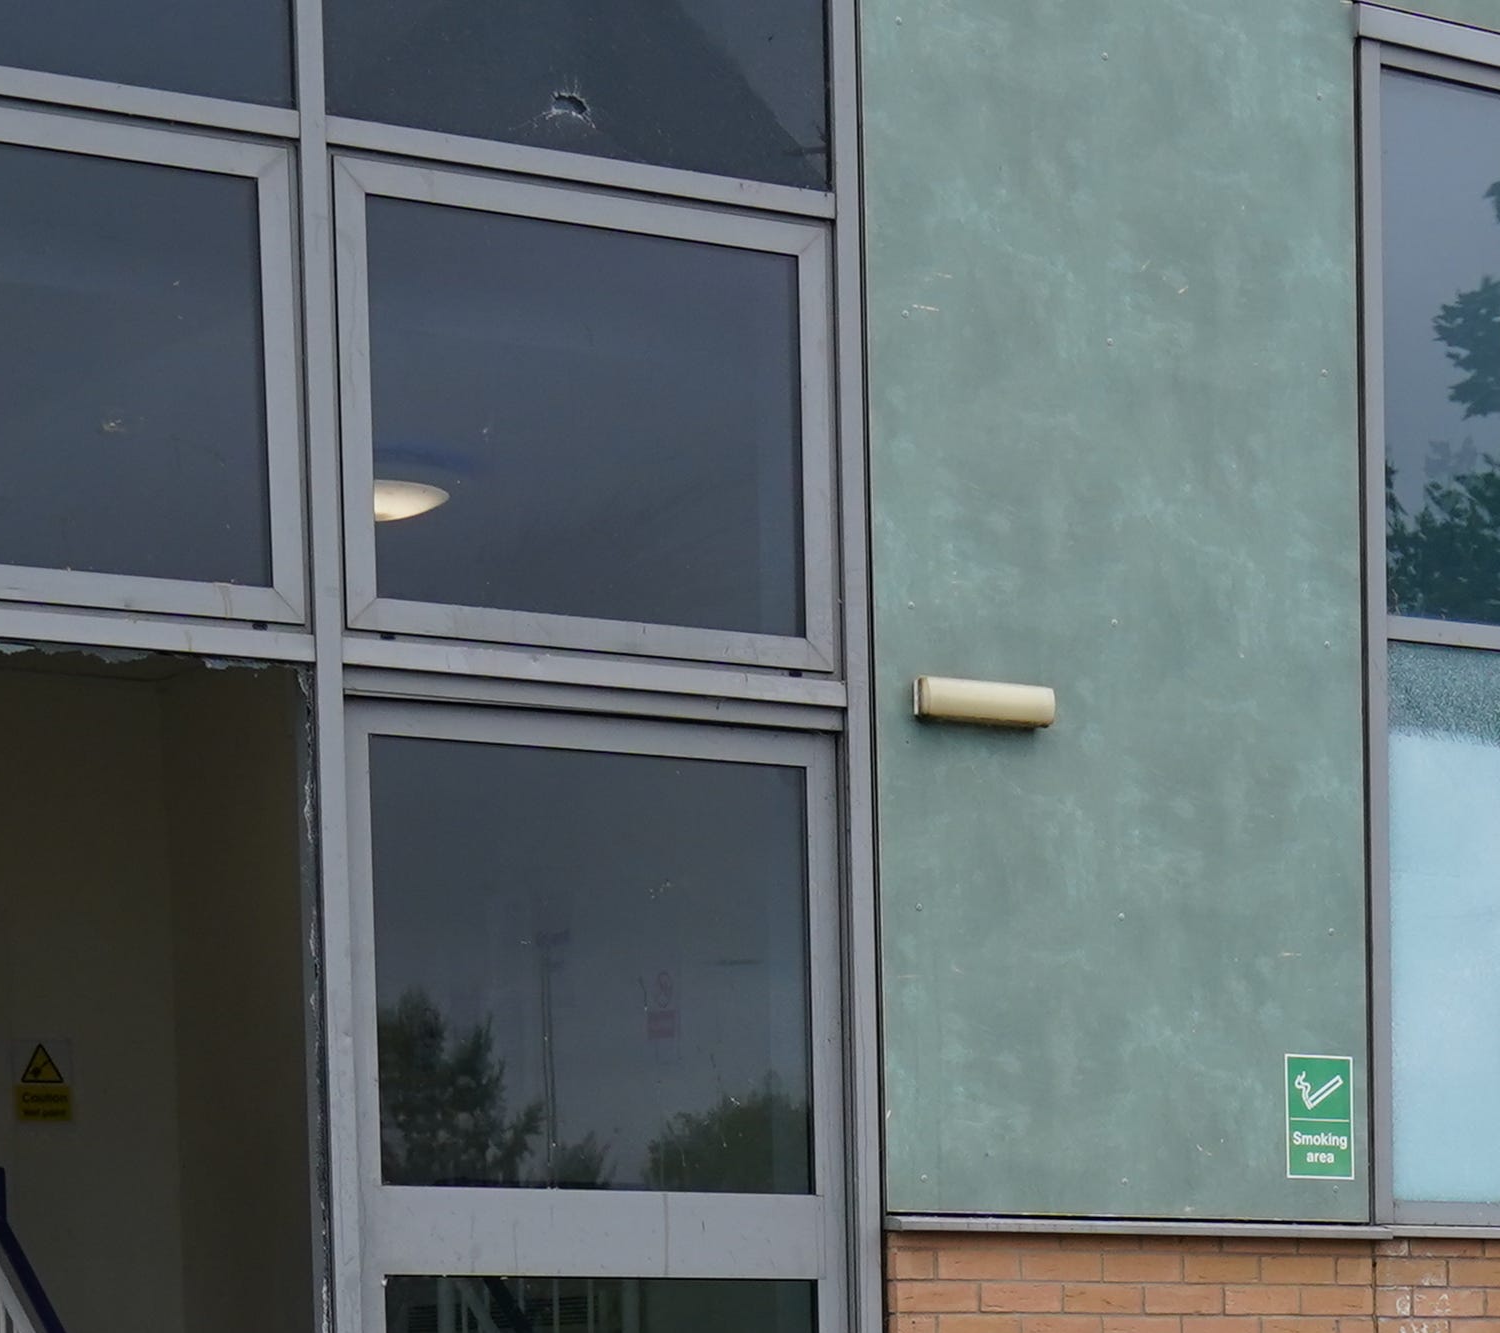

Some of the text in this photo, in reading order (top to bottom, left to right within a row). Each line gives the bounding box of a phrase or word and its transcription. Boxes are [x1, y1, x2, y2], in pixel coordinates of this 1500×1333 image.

[22, 1092, 68, 1103] Caution
[1293, 1131, 1348, 1150] Smoking
[1306, 1152, 1335, 1163] area
